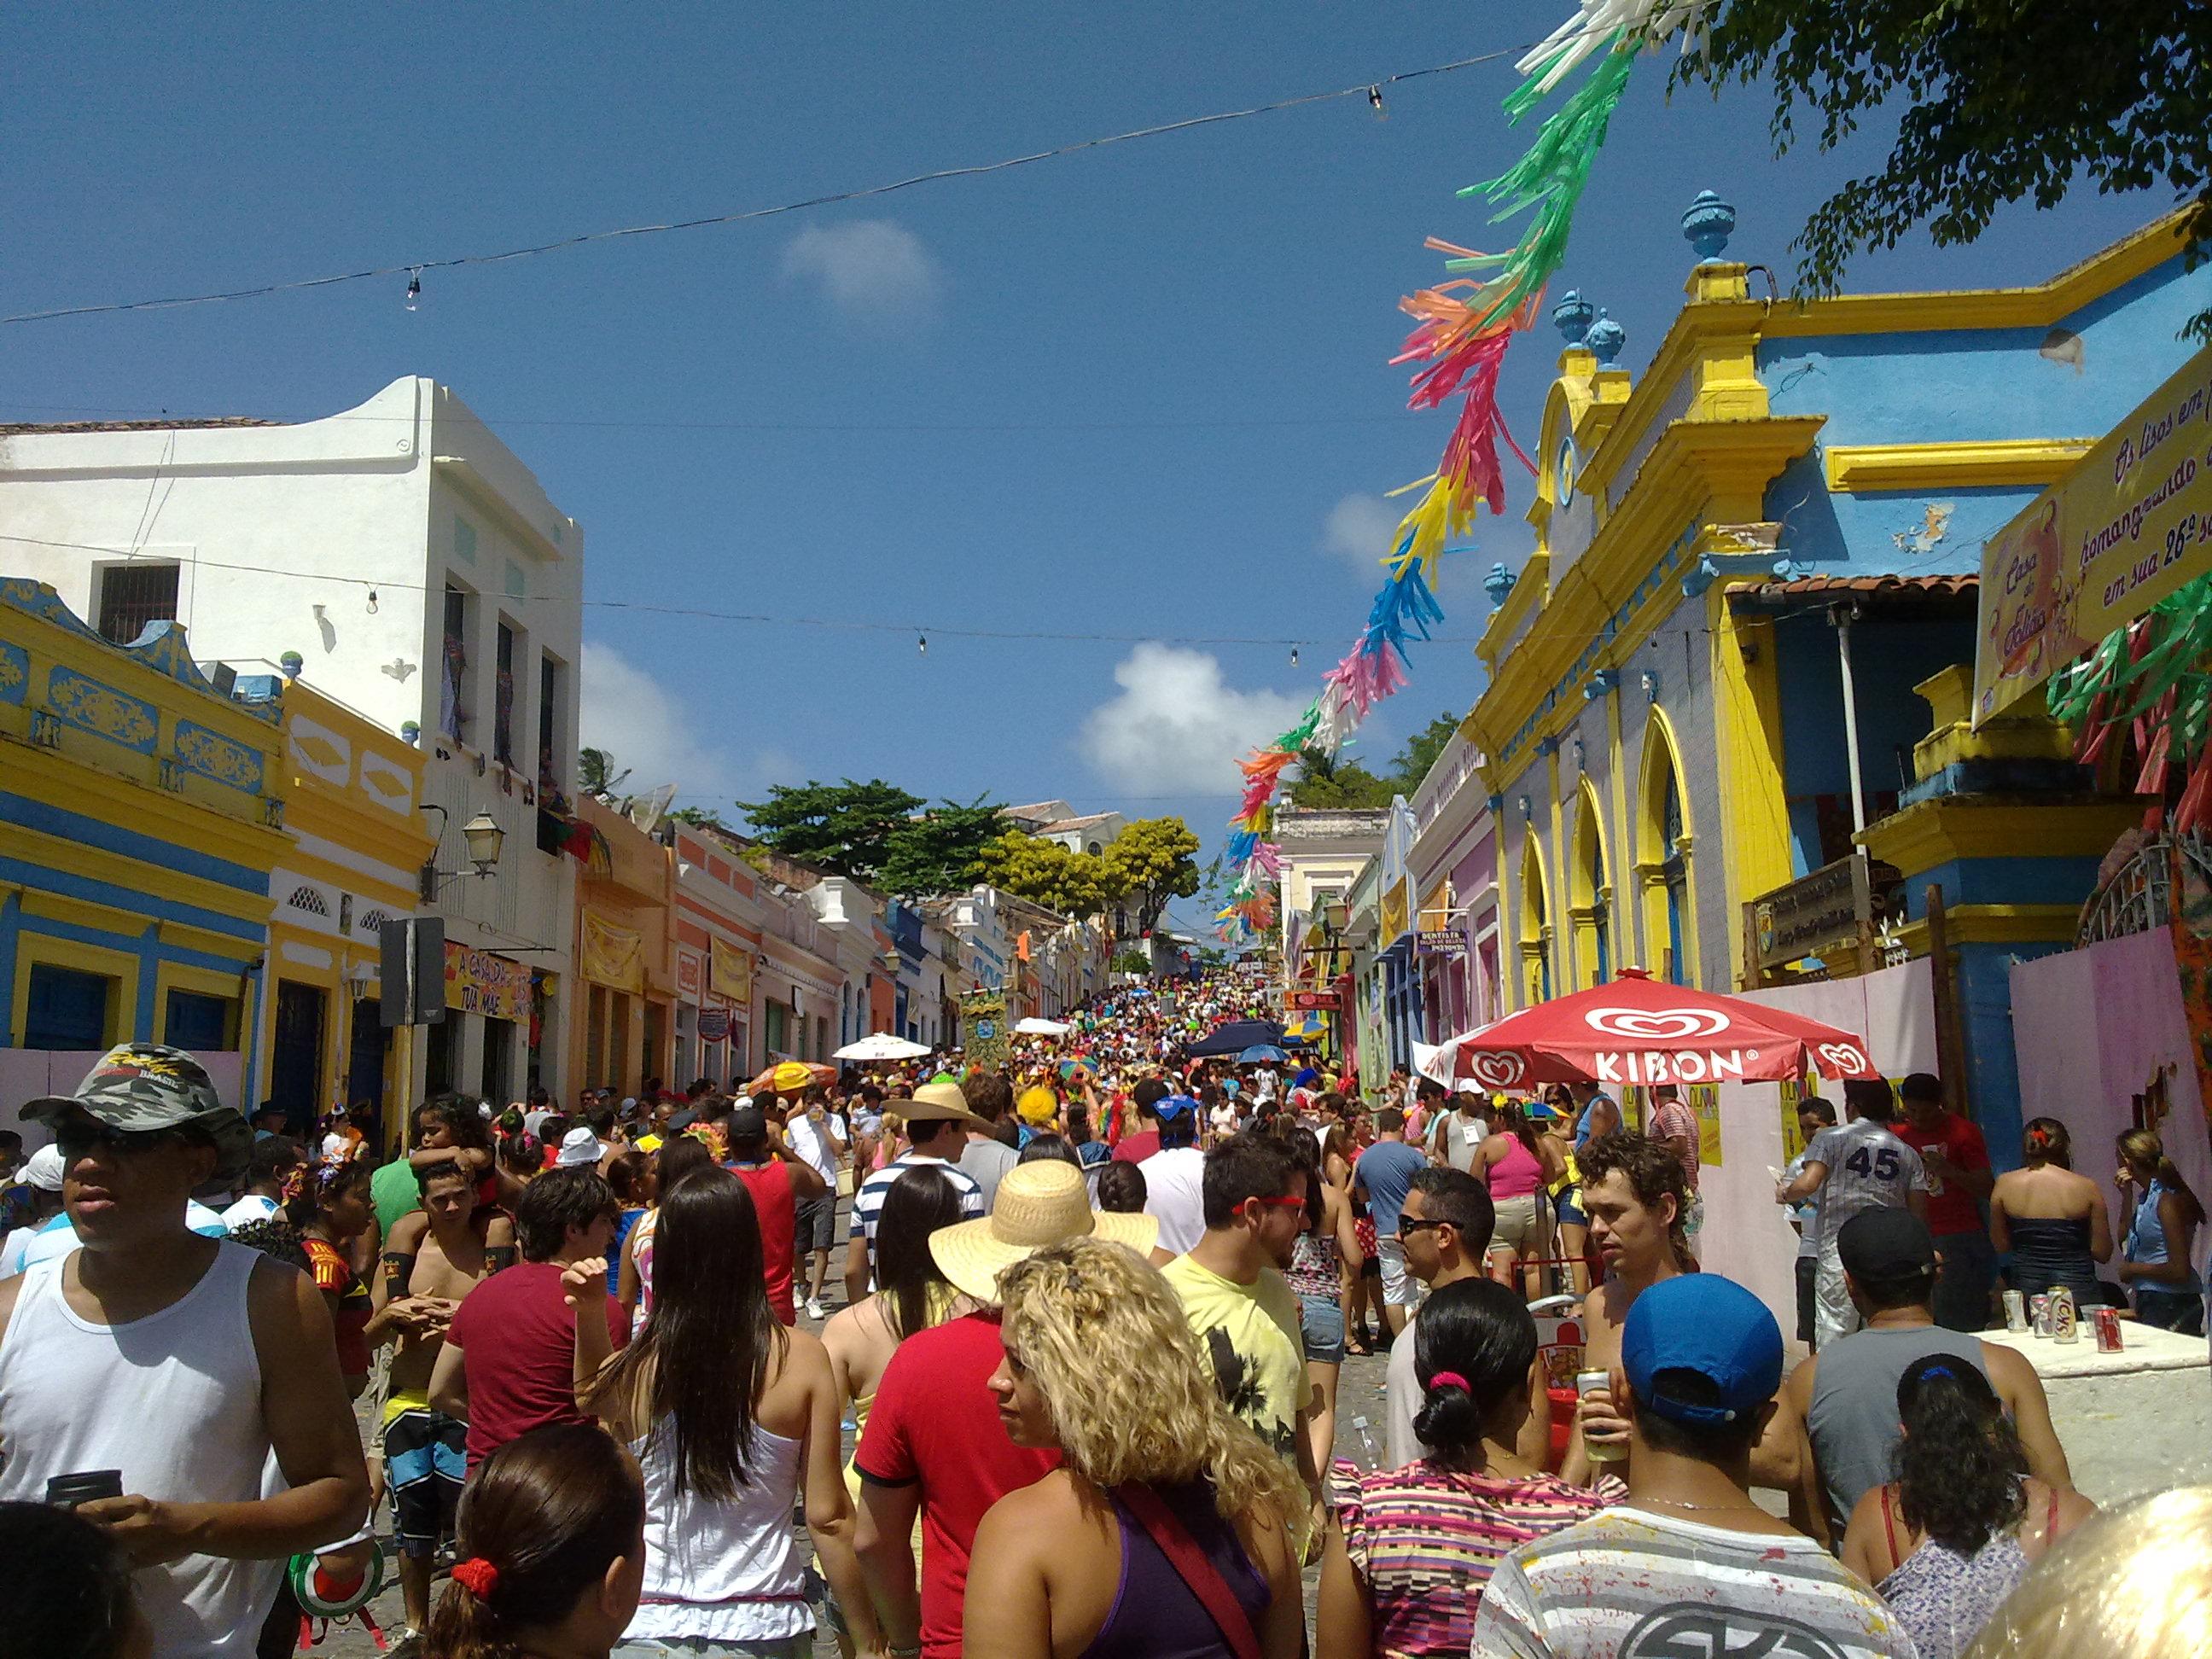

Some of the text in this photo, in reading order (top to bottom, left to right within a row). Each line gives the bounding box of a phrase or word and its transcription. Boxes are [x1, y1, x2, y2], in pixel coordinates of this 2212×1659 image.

[2114, 436, 2134, 486] Os
[2138, 410, 2174, 461] lisos
[2178, 387, 2204, 426] em
[2103, 574, 2126, 608] em
[2129, 550, 2159, 590] sua
[139, 1069, 178, 1089] BRASIL
[1595, 1049, 1744, 1083] KIBON
[1845, 1146, 1901, 1181] 45
[2055, 1297, 2073, 1333] SKOL
